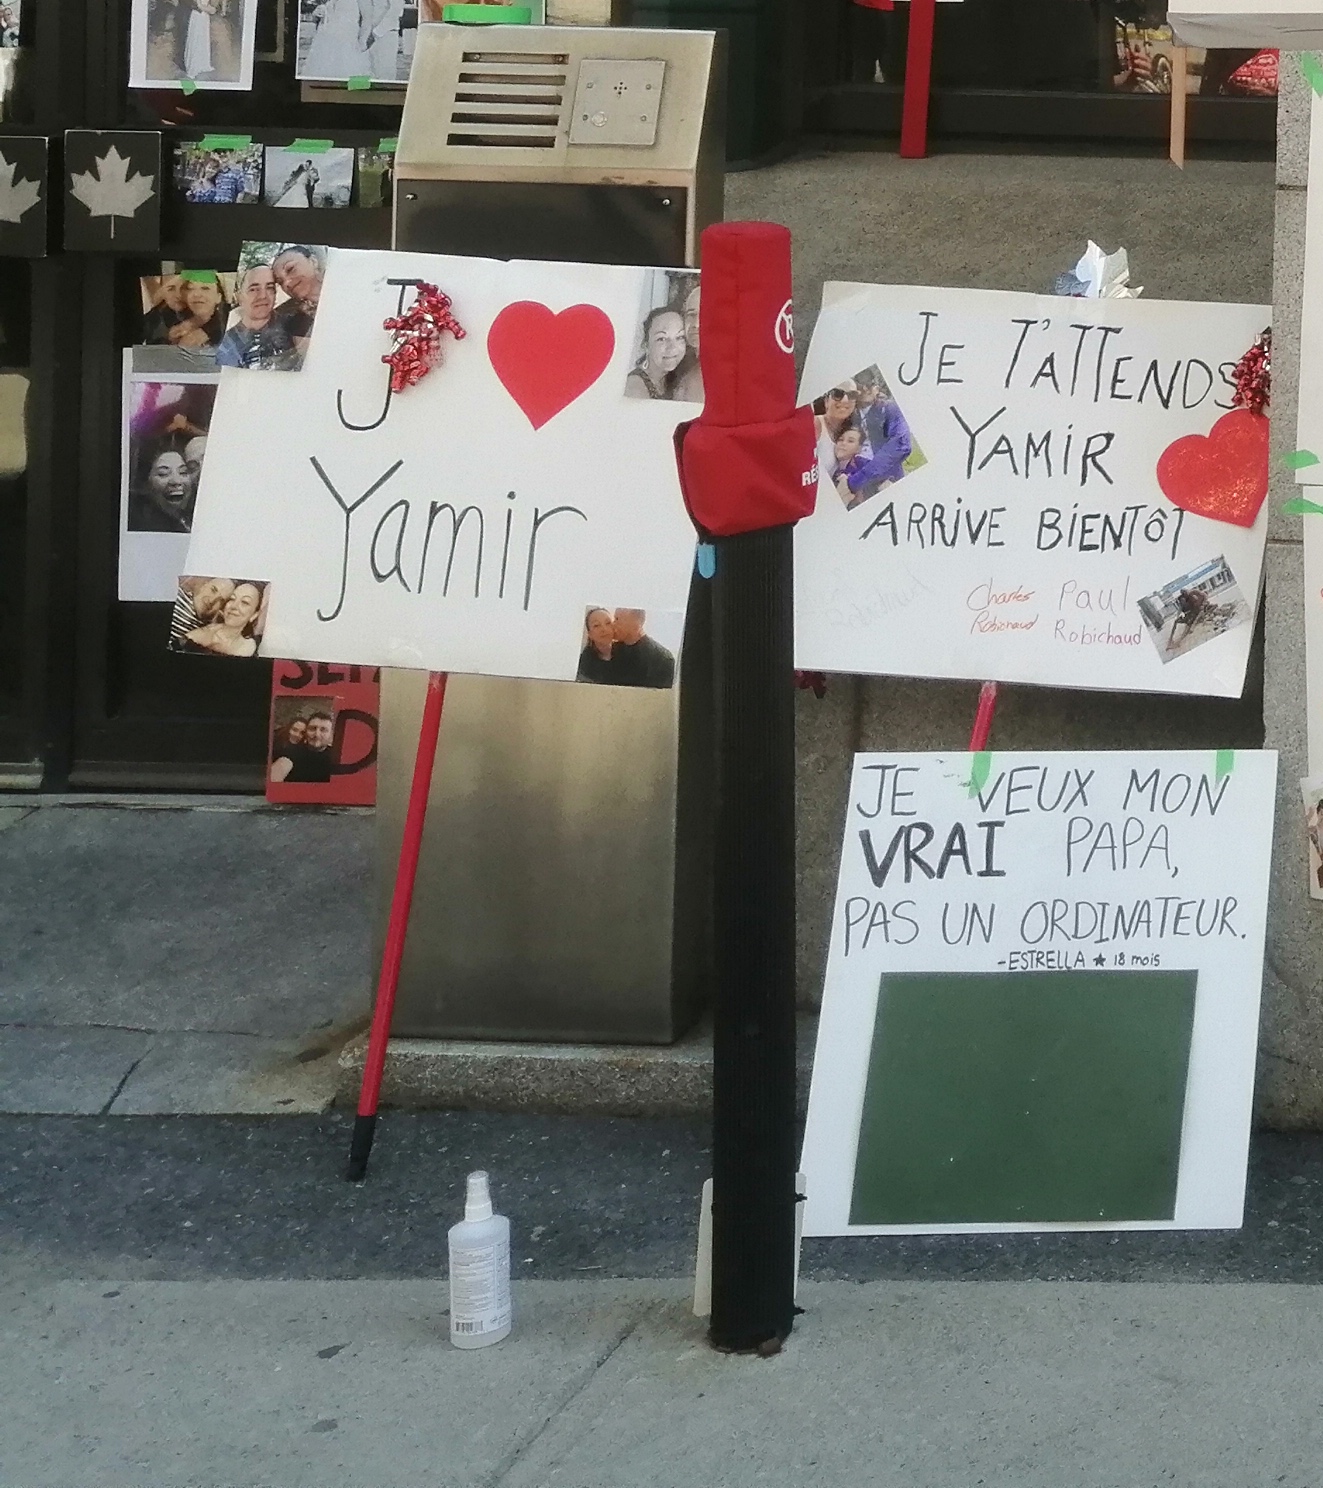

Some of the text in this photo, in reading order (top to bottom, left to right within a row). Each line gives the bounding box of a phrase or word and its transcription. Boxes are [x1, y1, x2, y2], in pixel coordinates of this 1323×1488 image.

[898, 311, 966, 386] JE
[309, 455, 588, 622] Yamir
[1059, 574, 1131, 617] Paul
[1054, 618, 1142, 647] Robichaud
[856, 763, 1231, 819] JE VEUX MON
[858, 815, 1180, 889] VRAI PAPA,
[843, 895, 1248, 958] PAS UN ORDINATEUR.
[1113, 952, 1126, 968] 18
